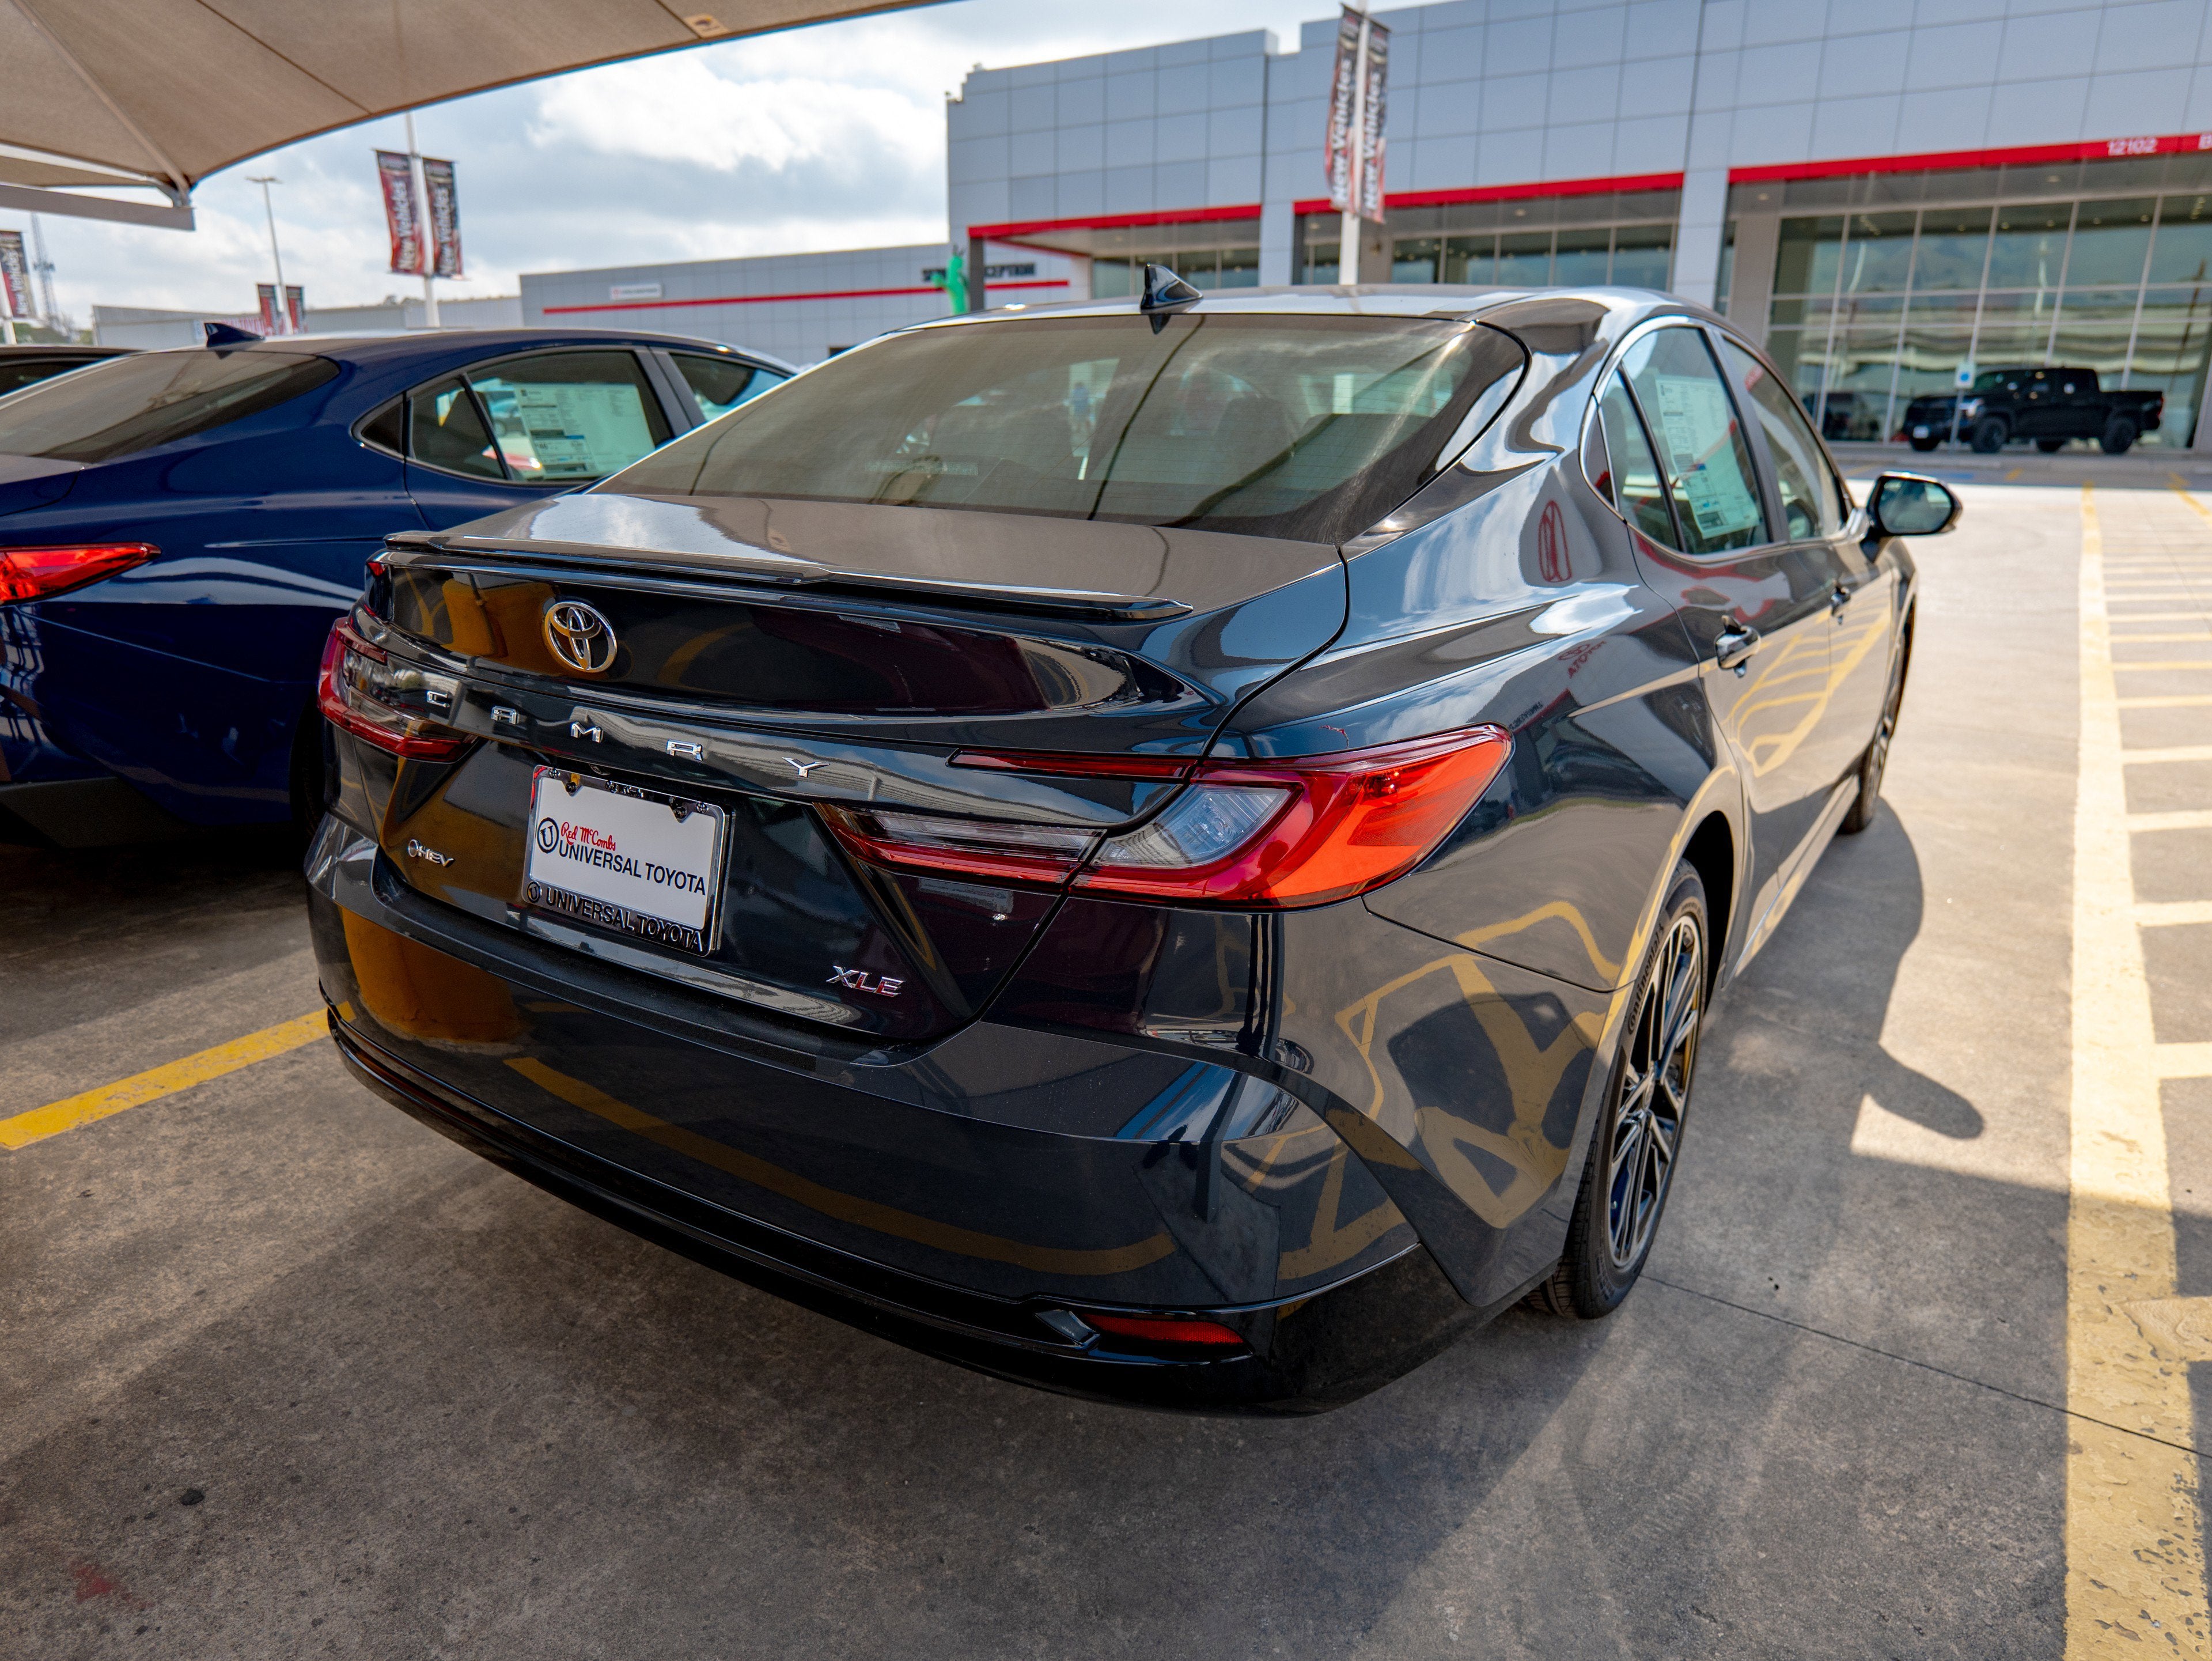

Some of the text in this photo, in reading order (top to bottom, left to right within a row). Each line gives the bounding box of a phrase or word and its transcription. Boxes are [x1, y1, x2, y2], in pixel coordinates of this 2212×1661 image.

[1332, 58, 1352, 149] Vehicles
[1363, 71, 1382, 160] Vehicles
[1332, 152, 1349, 201] New
[1363, 162, 1378, 210] New
[392, 180, 414, 237] Vehicles
[434, 187, 452, 243] Vehicles
[426, 690, 830, 778] CAMRY
[560, 822, 616, 851] Red McCombs
[559, 839, 706, 896] UNIVERSAL TOYOTA
[547, 887, 703, 952] UNIVERSAL TOYOTA
[825, 965, 904, 997] XLE
[1627, 932, 1661, 1035] Continental
